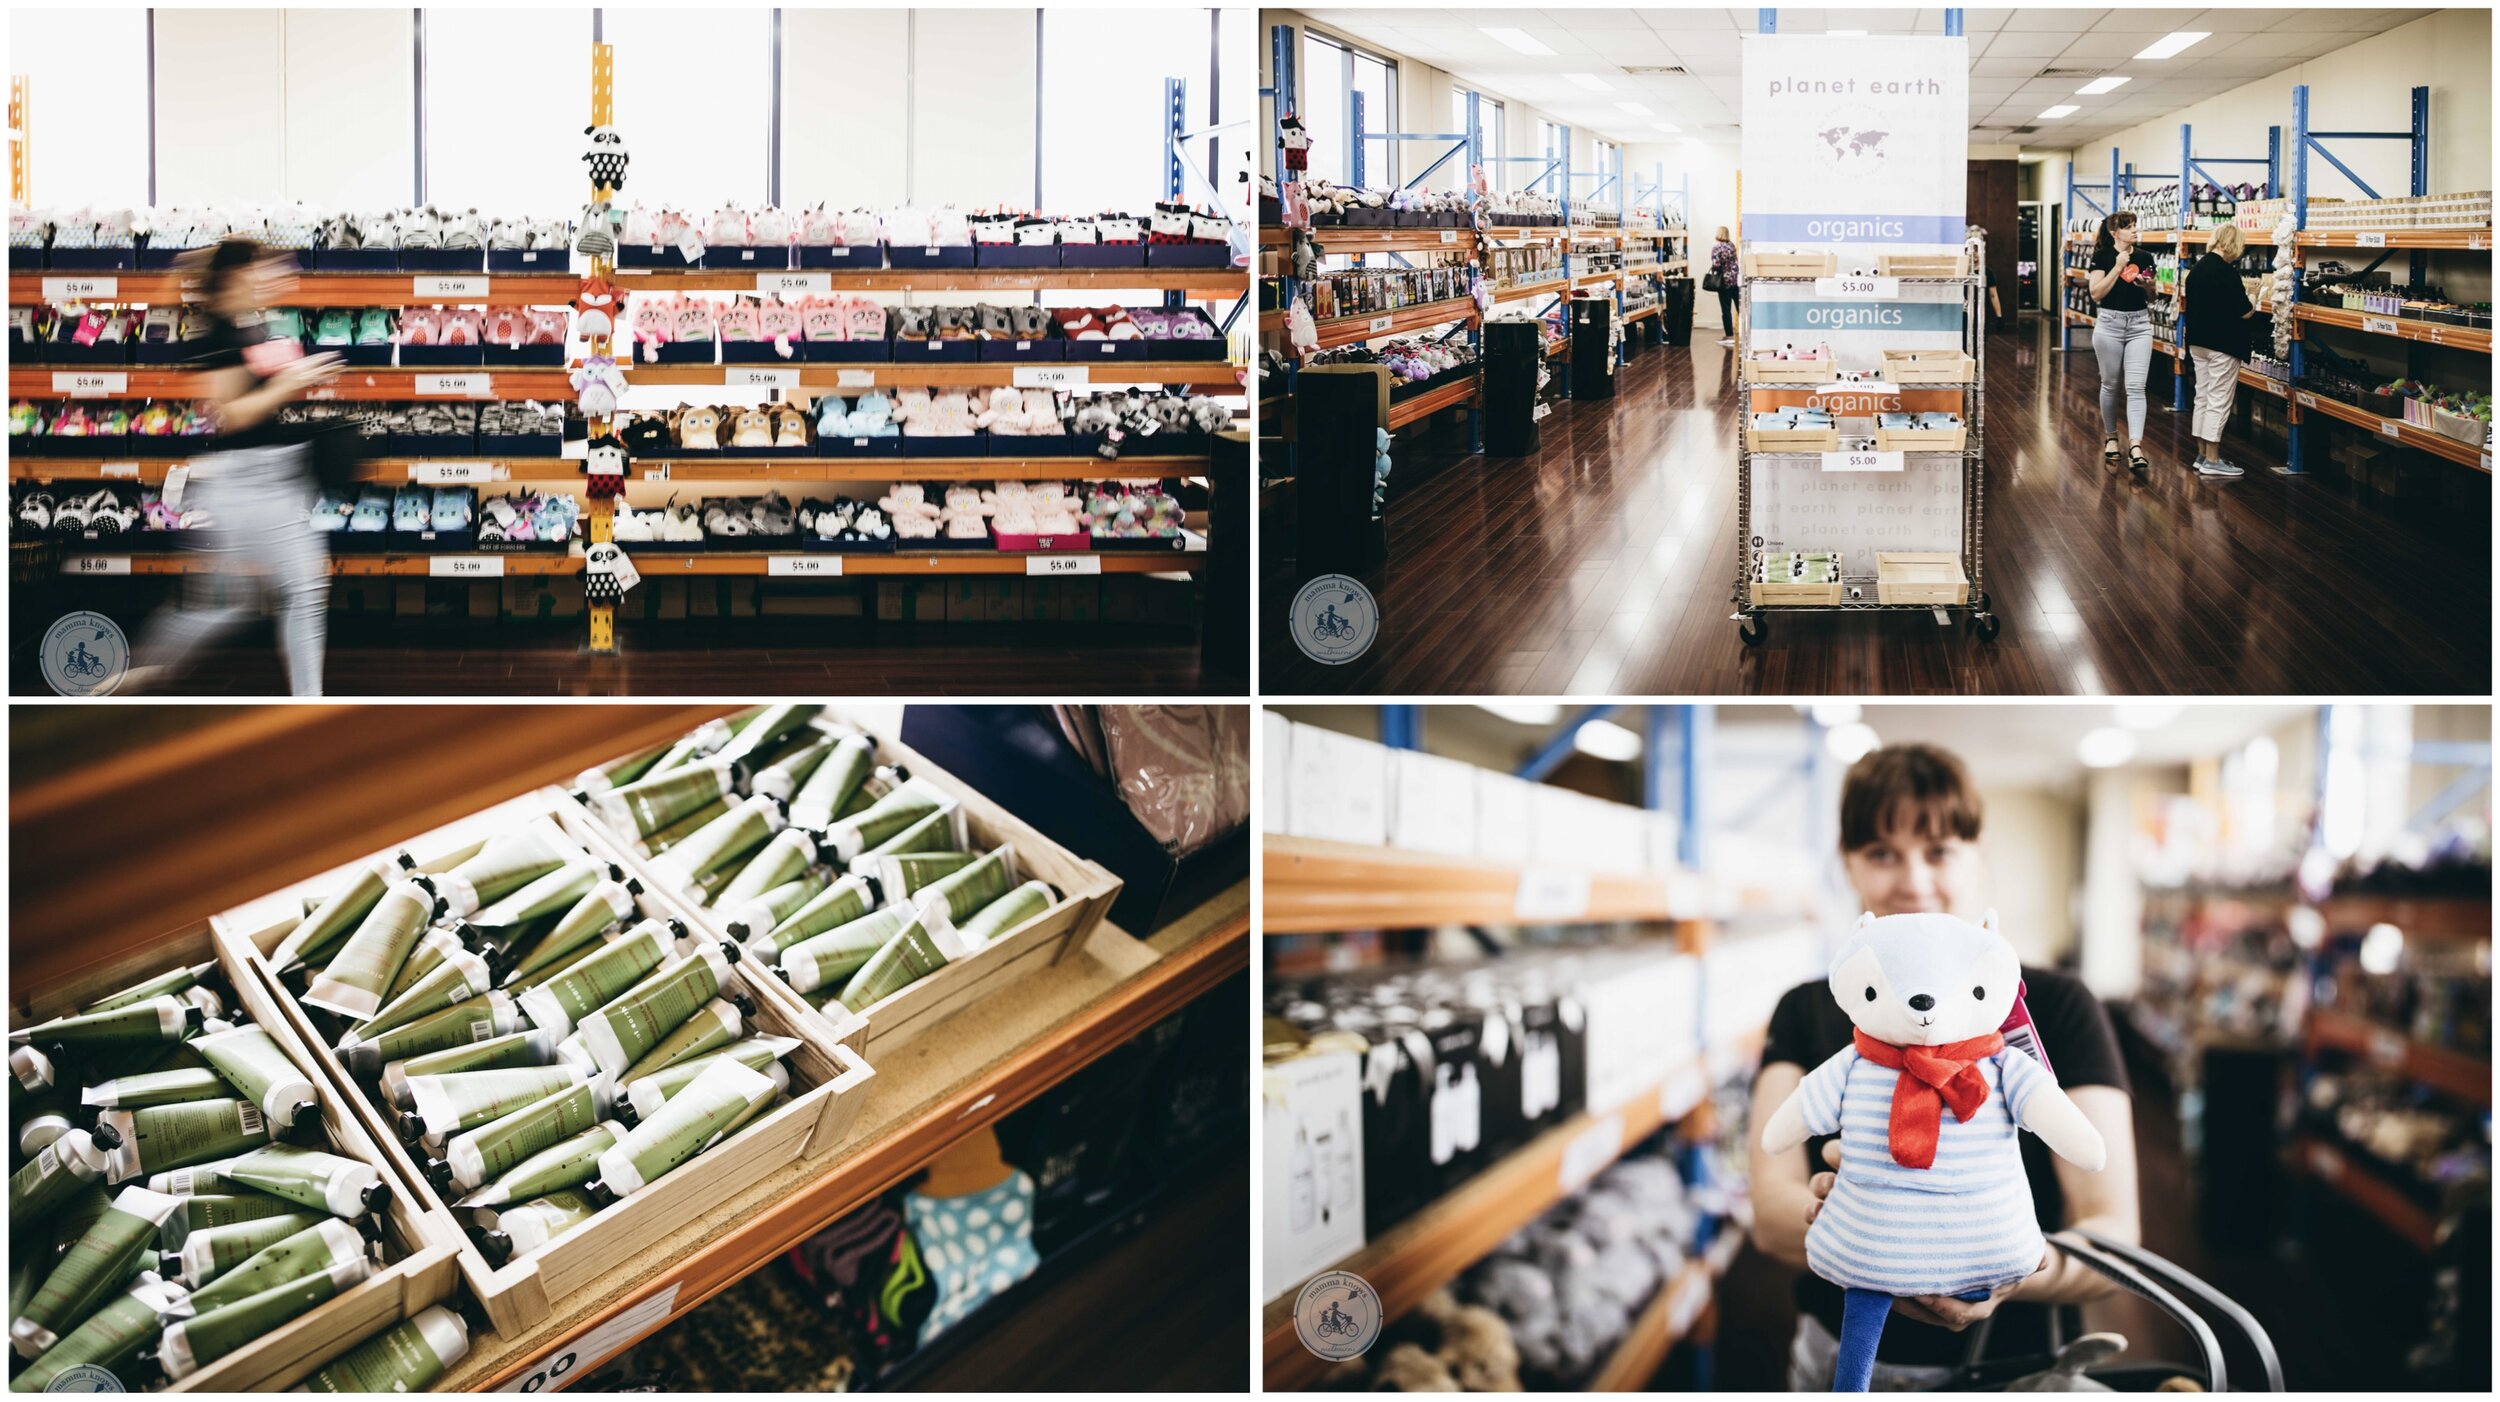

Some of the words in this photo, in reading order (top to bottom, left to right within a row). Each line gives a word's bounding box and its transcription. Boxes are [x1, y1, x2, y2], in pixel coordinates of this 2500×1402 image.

[1770, 76, 1856, 97] planet
[1870, 78, 1940, 95] earth
[1807, 216, 1904, 242] organics
[781, 277, 807, 287] $5.00
[1842, 282, 1874, 292] $5.00
[1806, 304, 1903, 330] organics
[749, 373, 776, 383] $5.00
[1806, 392, 1902, 416] organics
[1849, 456, 1877, 465] $5.00
[440, 467, 469, 477] $5.00
[1801, 480, 1857, 494] planet
[1866, 480, 1912, 492] earth
[1857, 503, 1913, 516] planet
[453, 562, 480, 571] $5.00
[792, 561, 819, 571] $5.00
[1050, 560, 1077, 571] $5.00
[618, 1004, 638, 1030] earth
